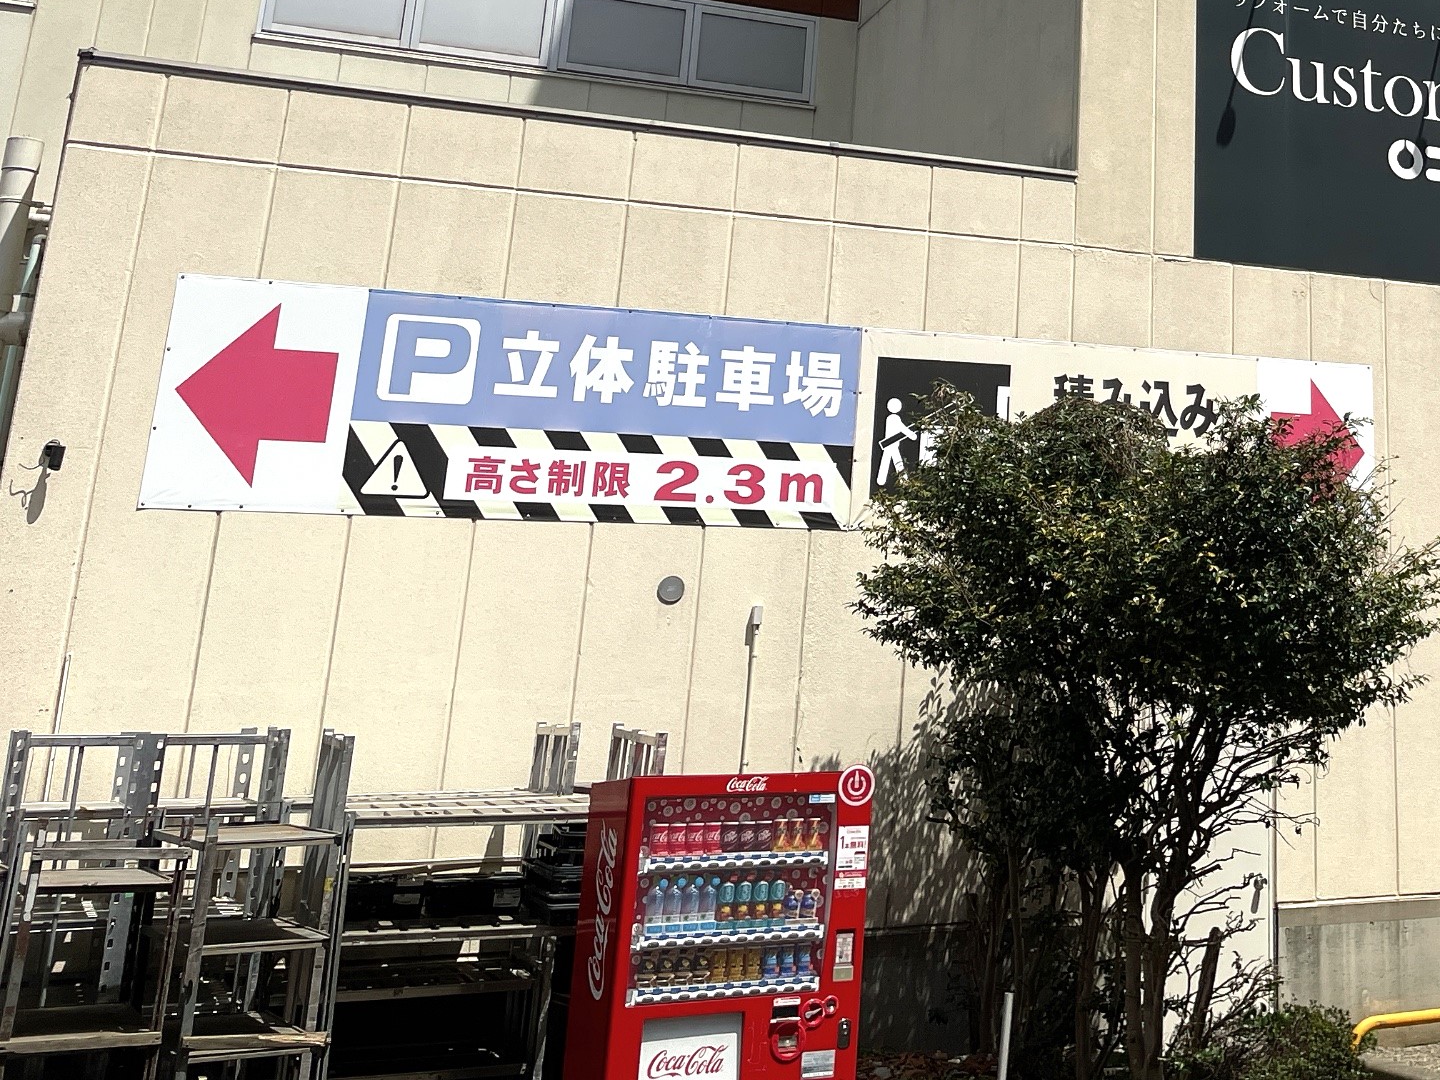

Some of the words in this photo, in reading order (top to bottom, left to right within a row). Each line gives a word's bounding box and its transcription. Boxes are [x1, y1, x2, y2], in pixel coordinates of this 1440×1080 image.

[493, 330, 844, 418] 立体駐車場
[464, 454, 632, 501] 高さ制限
[652, 459, 825, 506] 2.3m
